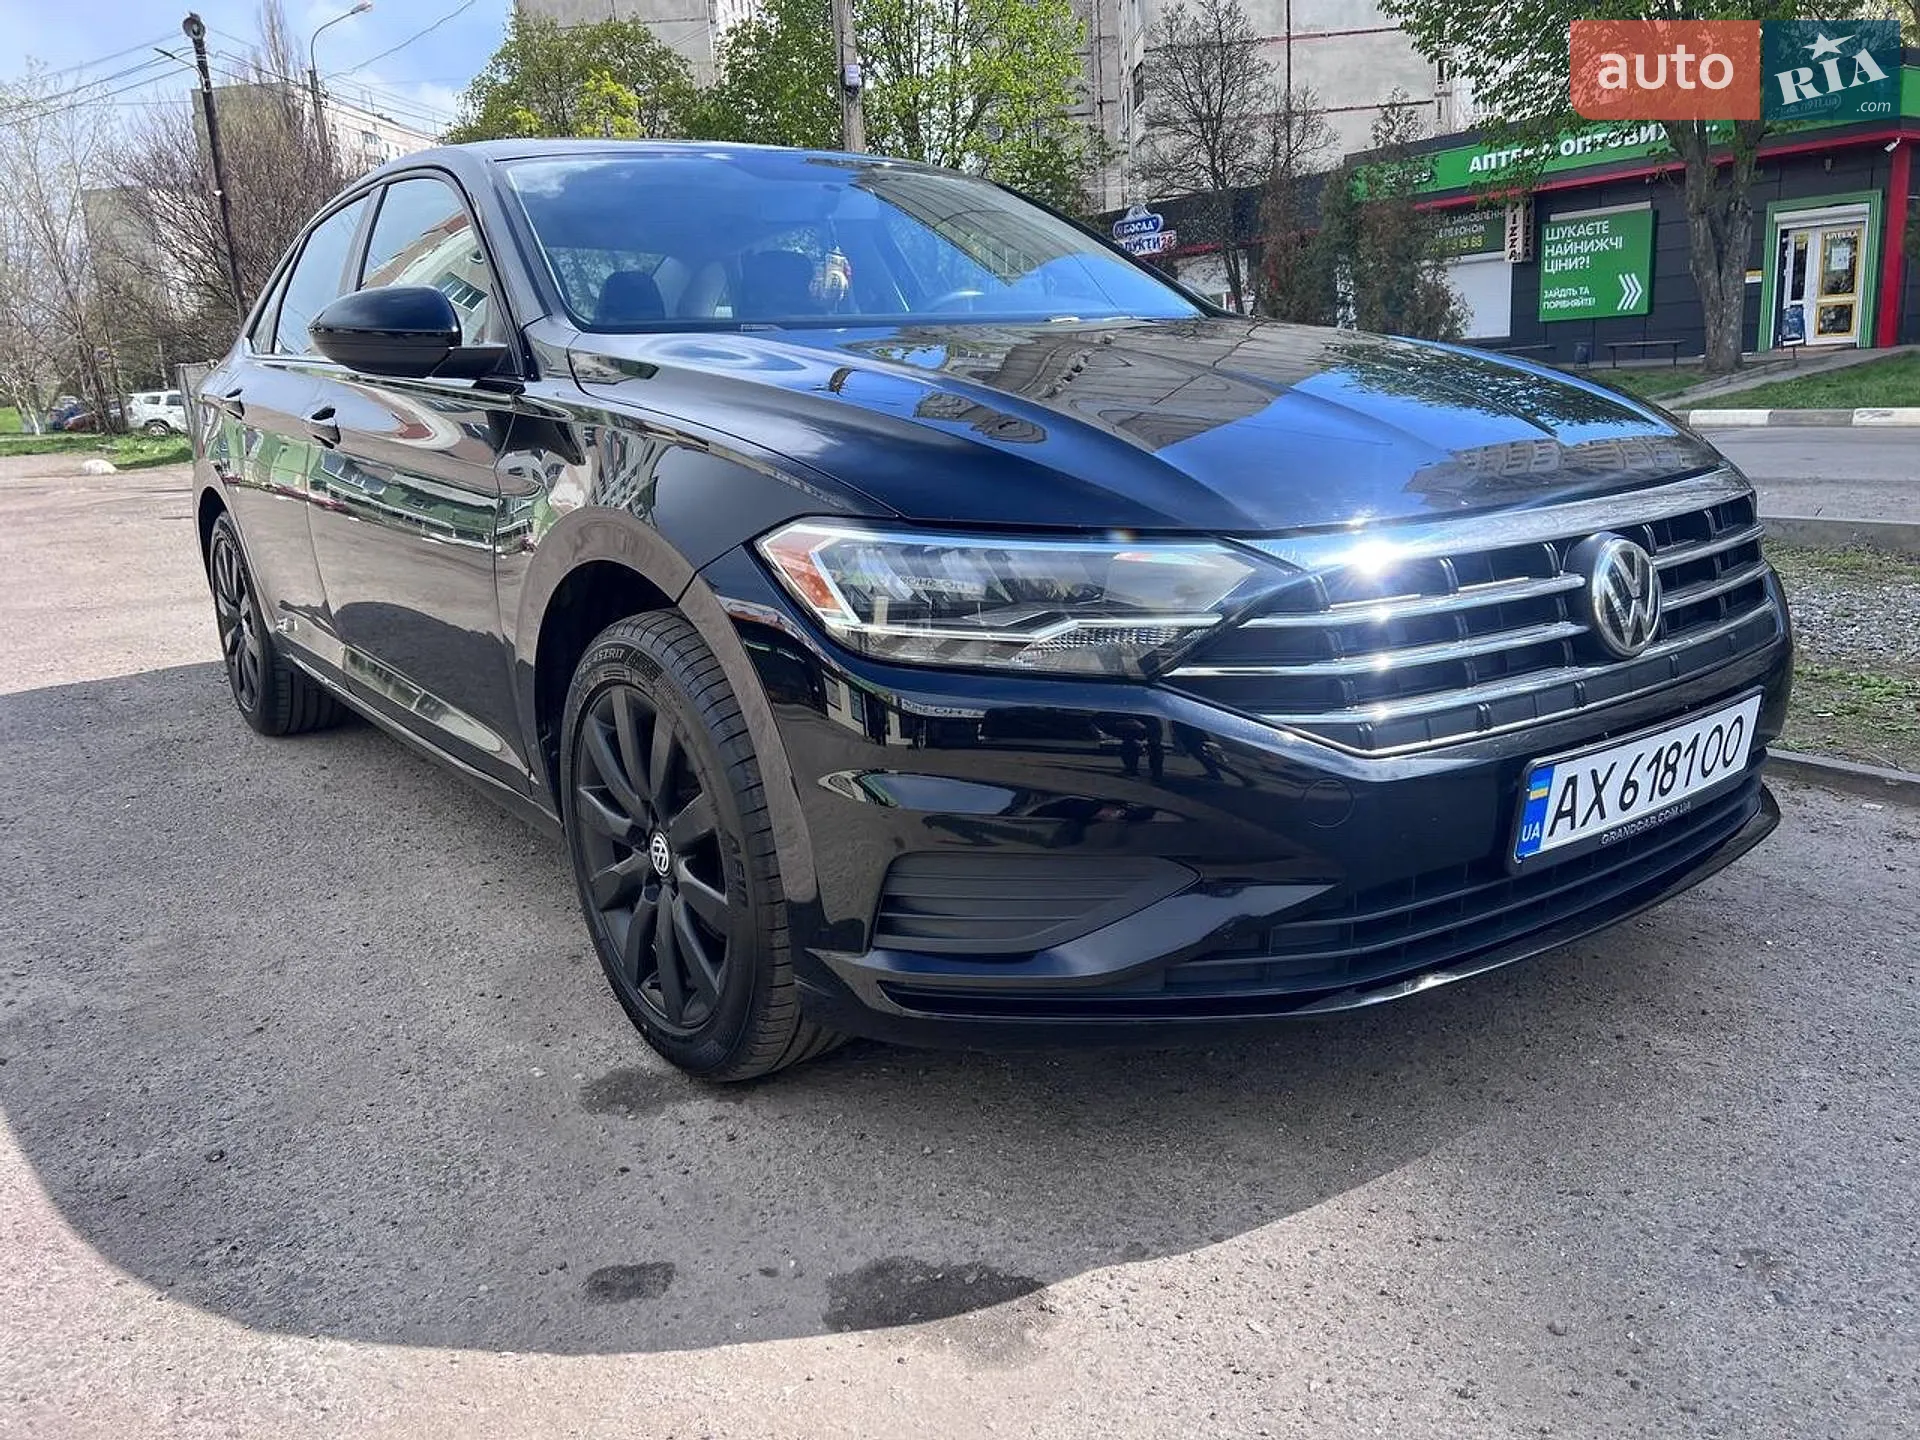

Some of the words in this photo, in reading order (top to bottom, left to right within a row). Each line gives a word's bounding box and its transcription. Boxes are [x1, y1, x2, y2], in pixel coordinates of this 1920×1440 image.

[1545, 220, 1609, 241] ШУКАЄТЕ
[1544, 236, 1623, 258] НАЙНИЖЧІ
[1522, 822, 1541, 842] UA
